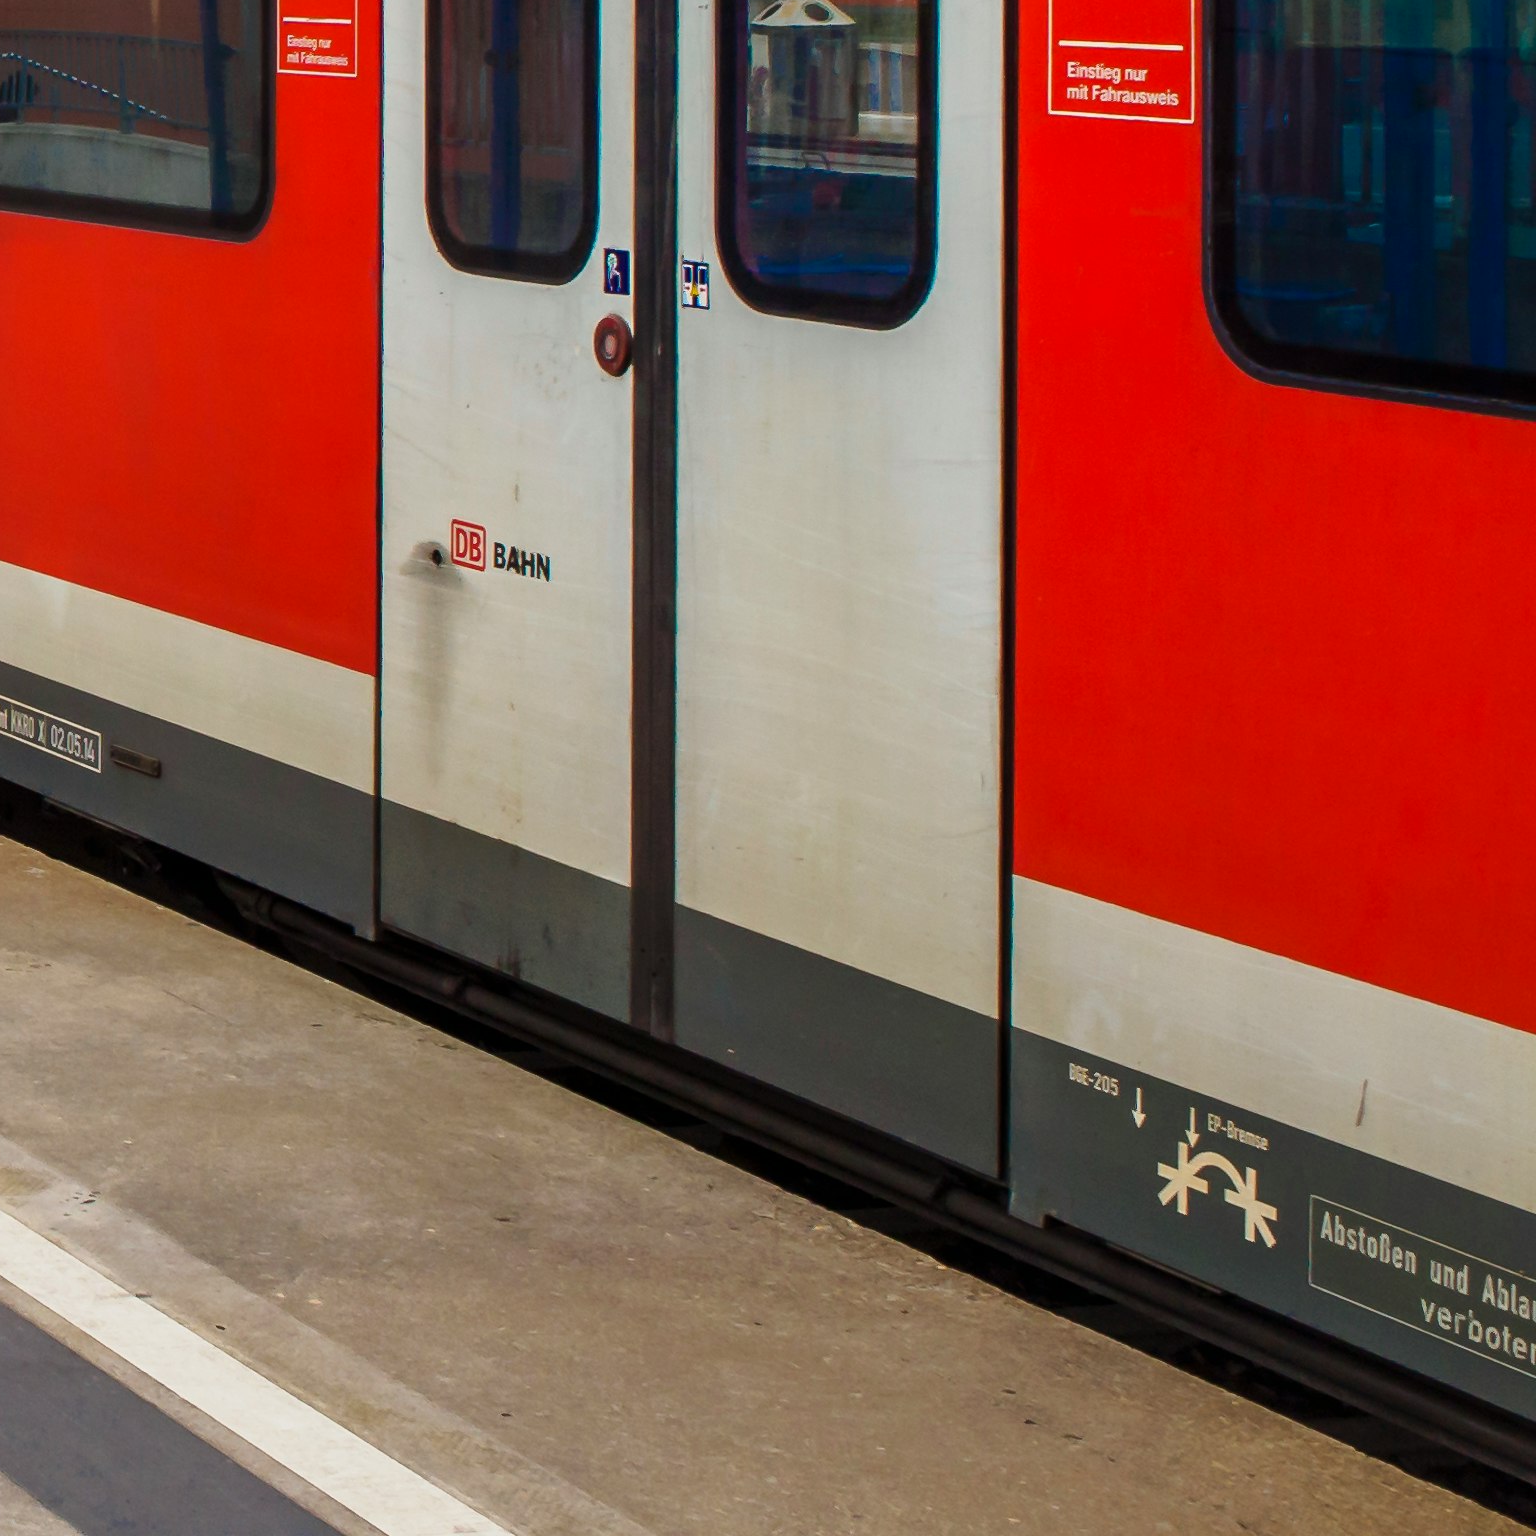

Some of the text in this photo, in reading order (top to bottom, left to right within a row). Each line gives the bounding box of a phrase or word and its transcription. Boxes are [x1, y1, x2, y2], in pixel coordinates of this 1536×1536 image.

[1066, 61, 1148, 84] Einstieg nur
[1066, 84, 1180, 107] mit Fahrausweis
[455, 527, 551, 583] DB BAHN
[50, 724, 95, 763] 02.05.14
[1207, 1112, 1270, 1151] EP-Bremse
[1320, 1210, 1417, 1276] Abstoßen
[1430, 1259, 1469, 1296] und
